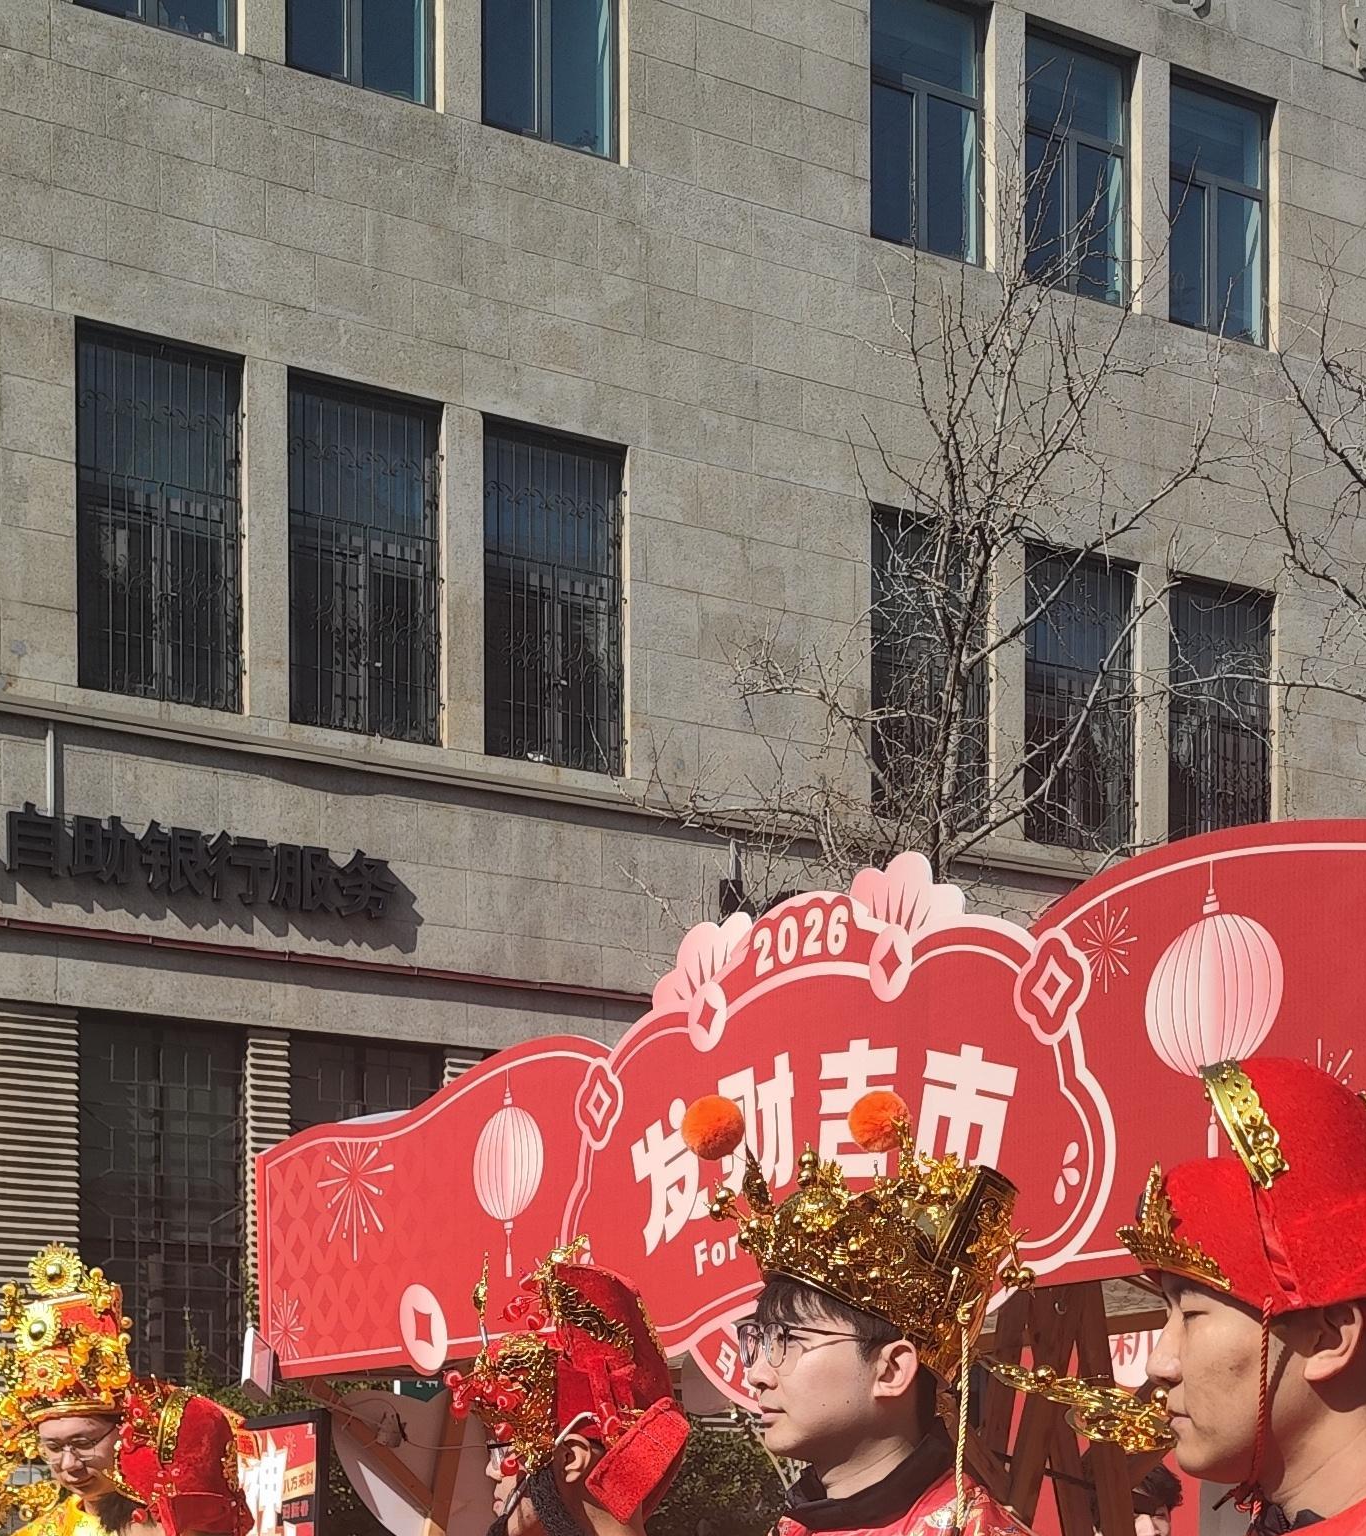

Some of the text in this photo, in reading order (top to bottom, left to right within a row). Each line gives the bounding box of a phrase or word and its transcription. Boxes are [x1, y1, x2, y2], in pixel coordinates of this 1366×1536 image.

[6, 801, 391, 920] 自助银行服务
[752, 903, 849, 978] 2026
[630, 1037, 1019, 1258] 发财吉市
